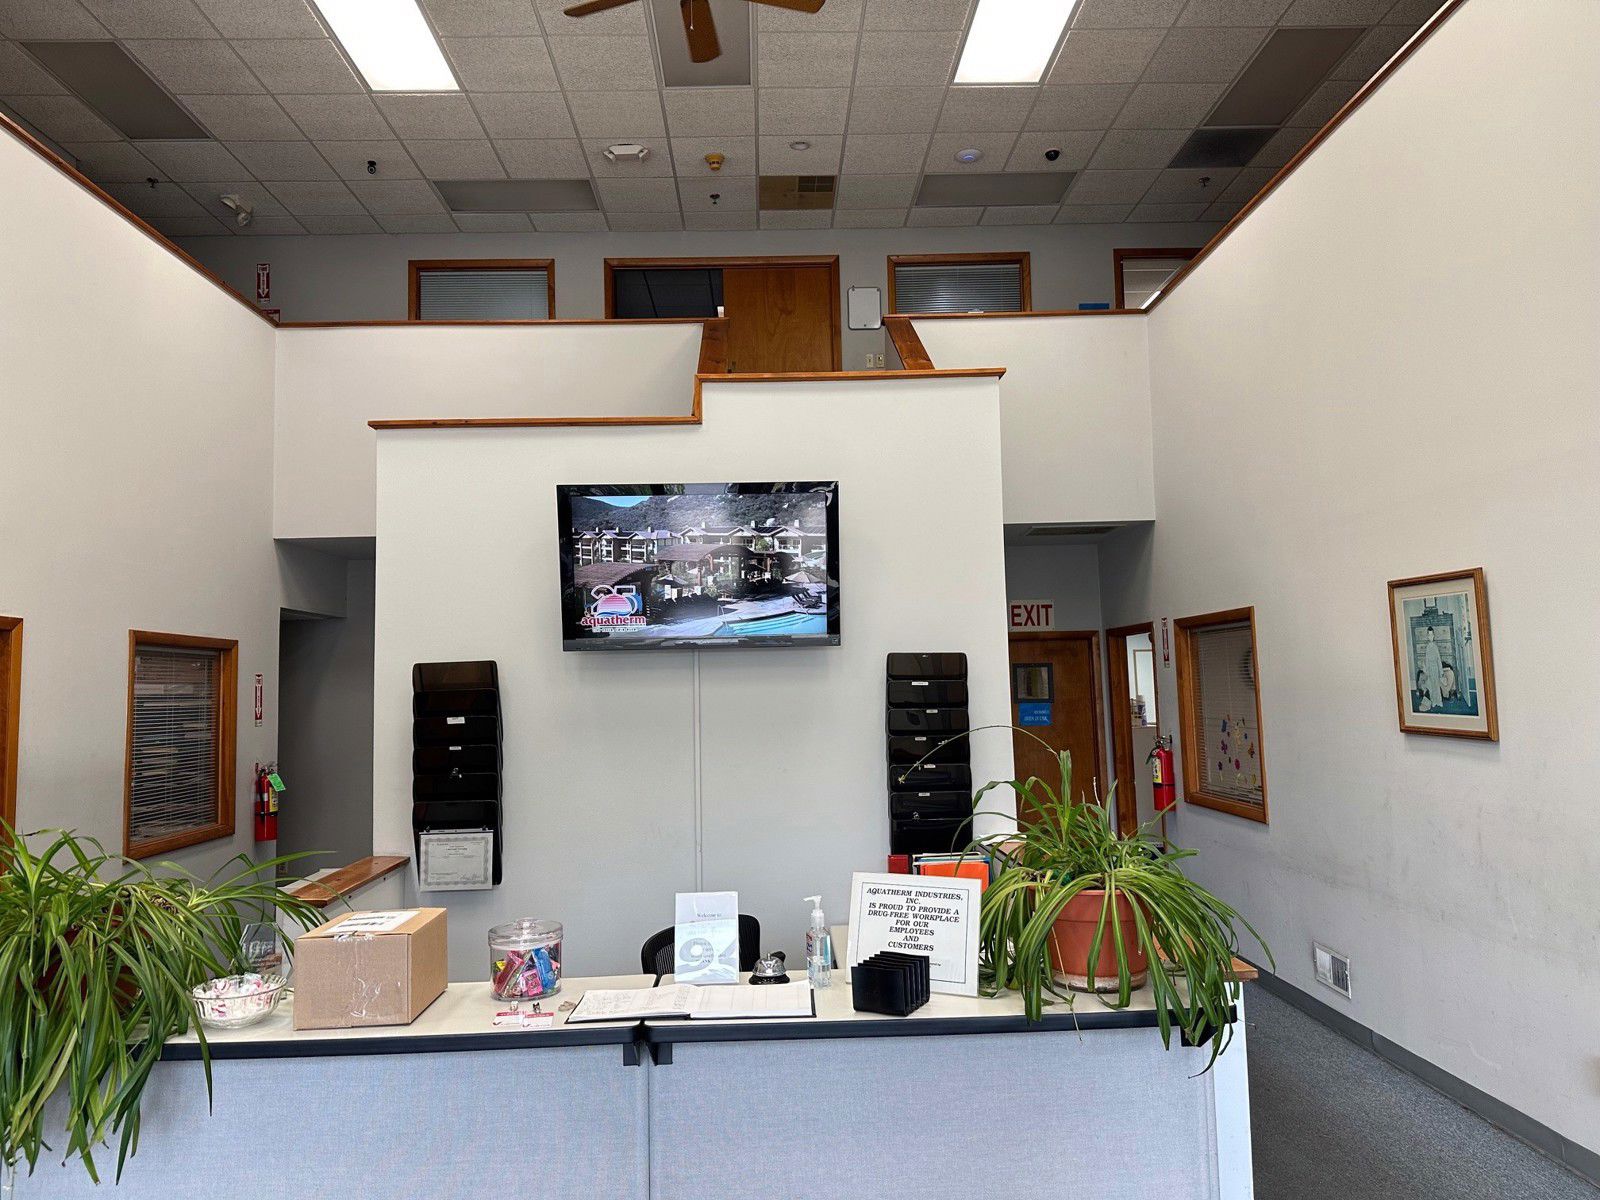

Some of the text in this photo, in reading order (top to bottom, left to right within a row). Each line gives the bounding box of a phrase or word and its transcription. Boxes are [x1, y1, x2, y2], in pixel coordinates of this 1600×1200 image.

[581, 615, 646, 626] aquatherm
[1010, 604, 1052, 627] EXIT
[866, 887, 912, 896] AQUATHERM
[918, 906, 951, 914] PROVIDE
[868, 909, 960, 923] DRUG-FREE WORKPLACE
[913, 920, 929, 928] OUR
[889, 926, 935, 936] EMPLOYEES
[887, 941, 934, 952] CUSTOMERS
